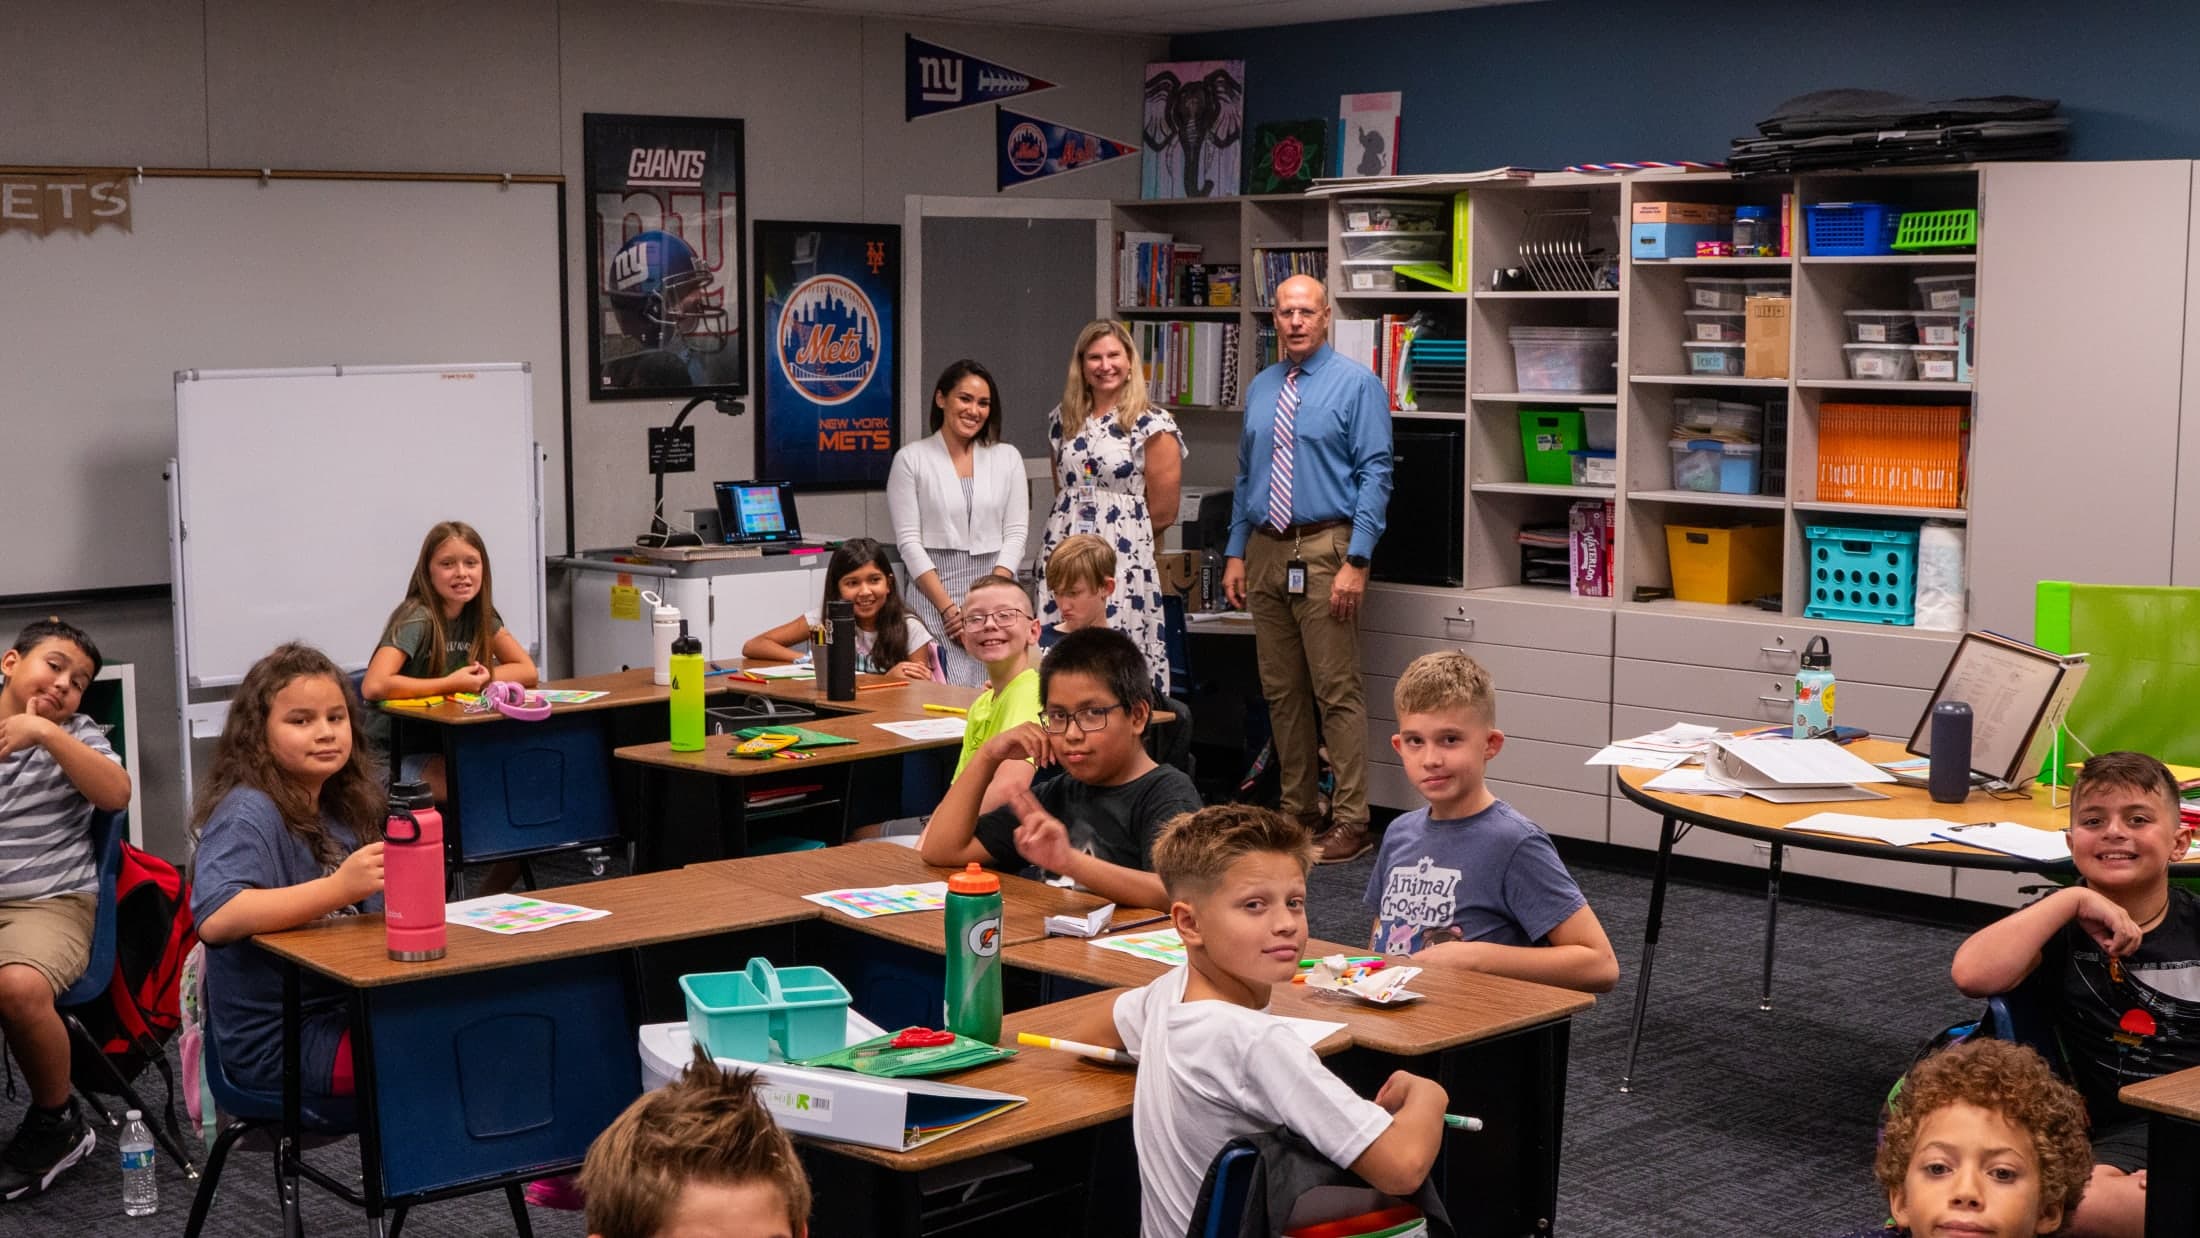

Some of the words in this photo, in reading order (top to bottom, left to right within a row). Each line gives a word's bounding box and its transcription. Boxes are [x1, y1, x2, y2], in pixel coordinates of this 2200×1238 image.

[627, 148, 706, 174] GIANTS
[2, 182, 127, 219] ETS
[796, 323, 863, 364] Mets
[819, 418, 848, 430] NEW
[852, 417, 889, 429] YORK
[818, 430, 891, 452] METS
[1582, 527, 1600, 581] WATERLOO
[1388, 873, 1456, 898] Animal
[1382, 897, 1452, 923] Crossing
[968, 918, 1000, 957] G
